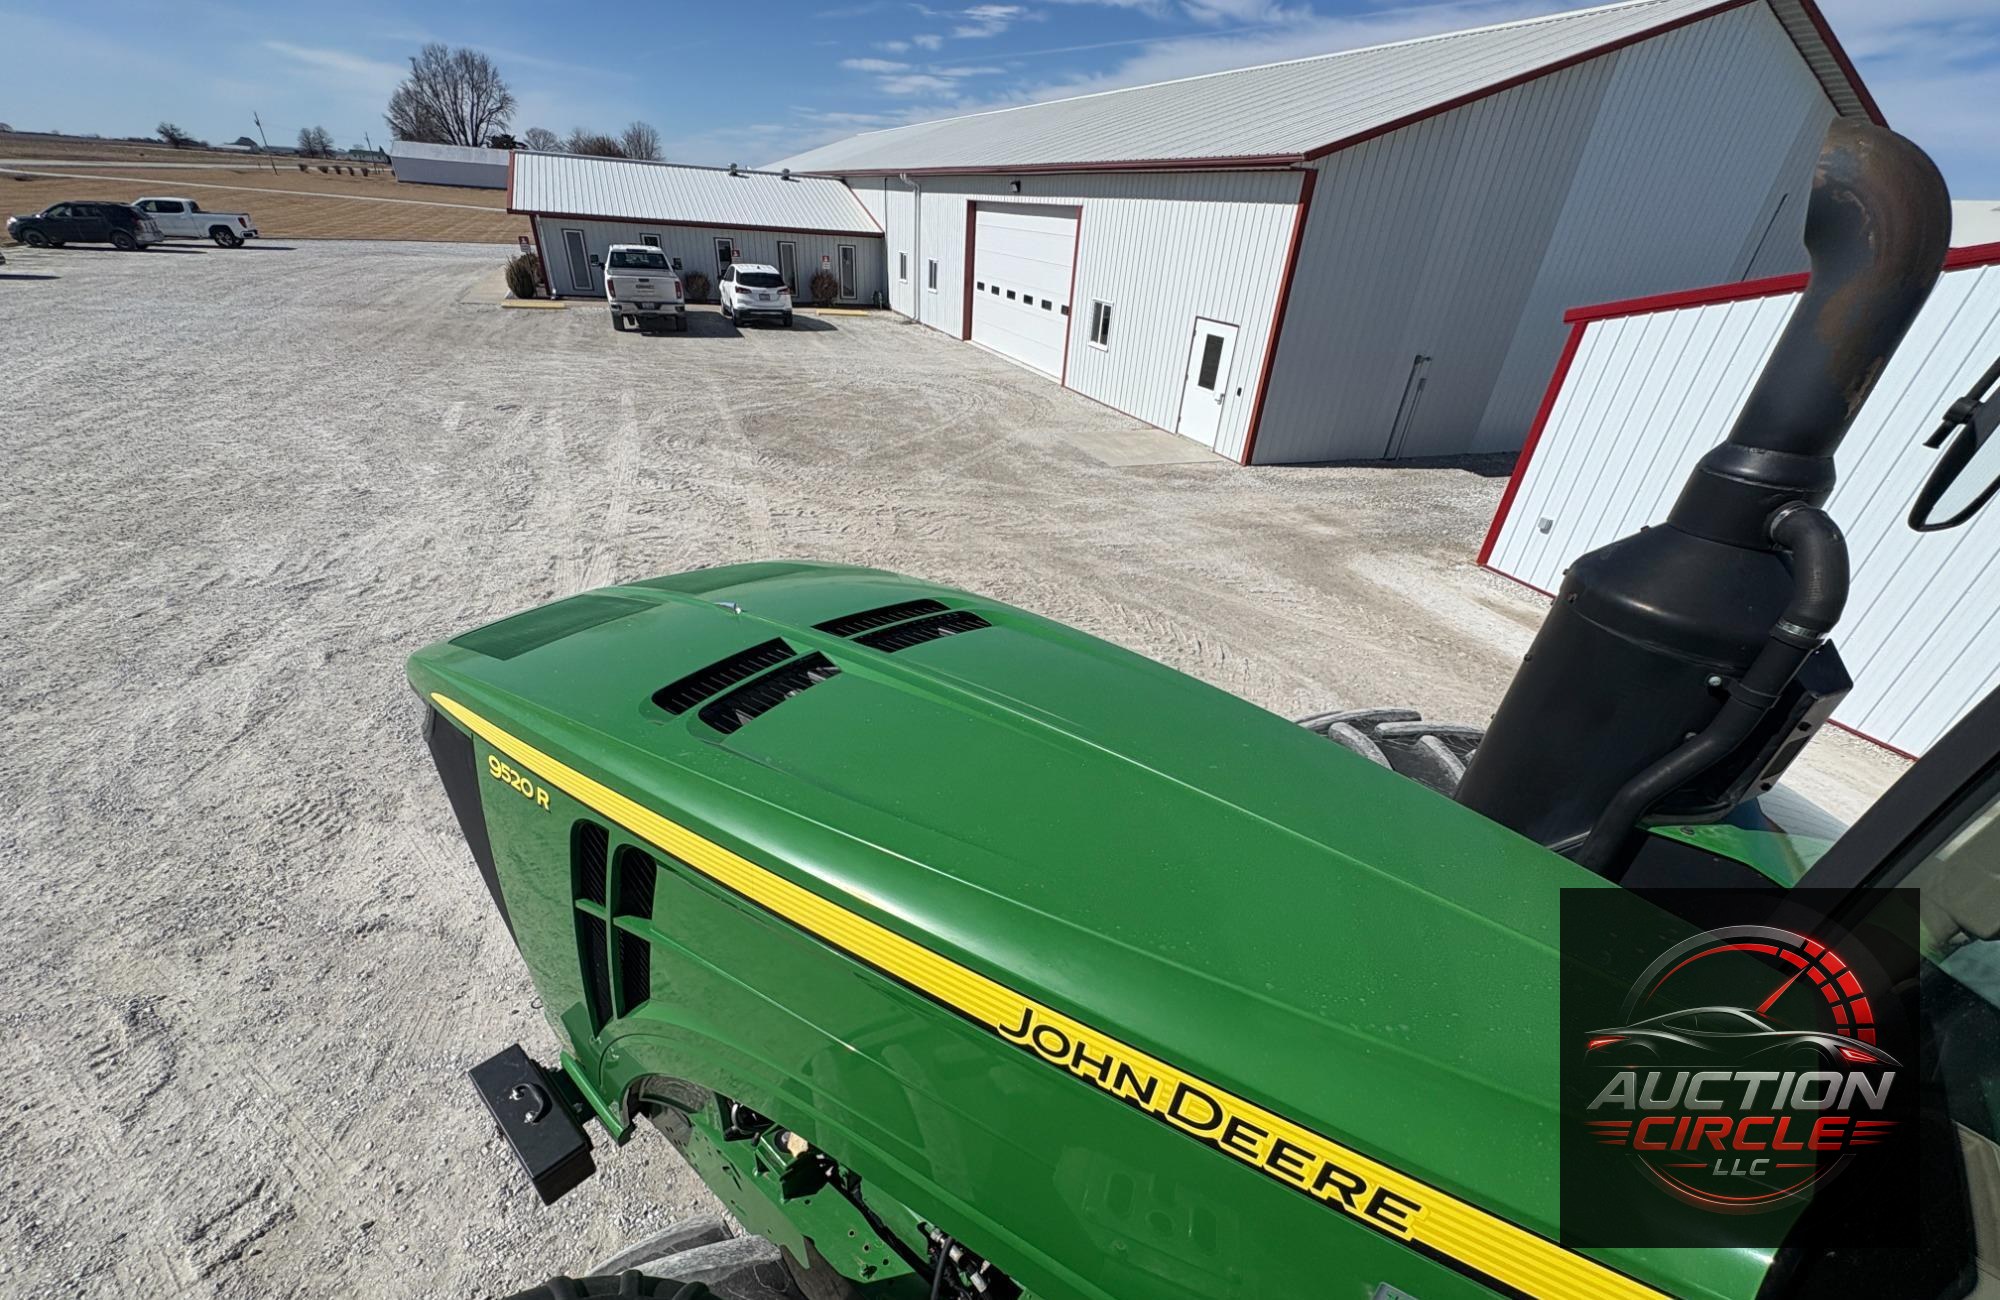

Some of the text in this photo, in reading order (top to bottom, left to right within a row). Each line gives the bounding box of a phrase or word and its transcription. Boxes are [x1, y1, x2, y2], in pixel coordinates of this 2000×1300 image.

[488, 754, 550, 811] 9520 R
[998, 1007, 1422, 1234] JOHN DEERE
